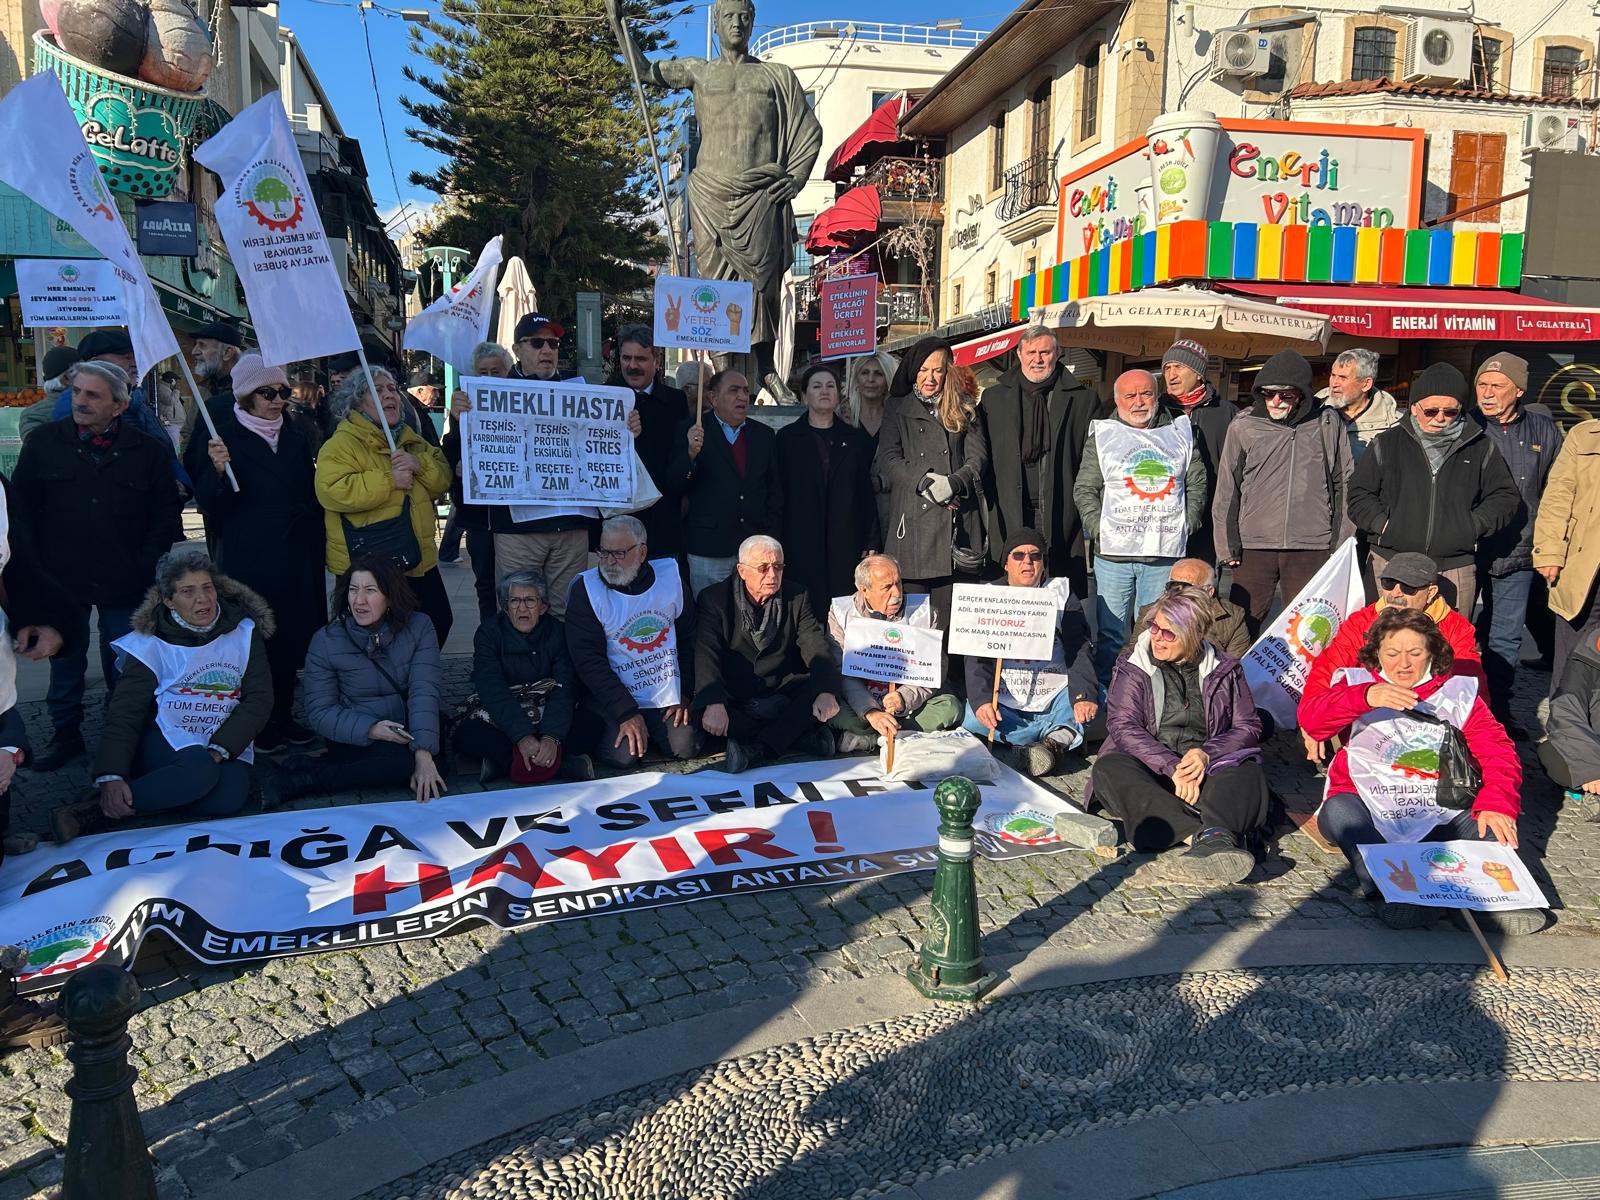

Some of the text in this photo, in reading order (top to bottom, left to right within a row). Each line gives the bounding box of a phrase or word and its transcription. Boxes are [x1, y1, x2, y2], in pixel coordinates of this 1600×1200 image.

[1108, 305, 1207, 318] LA GELATERIA
[1233, 311, 1313, 330] LA GELATERIA
[1331, 315, 1366, 325] ATERIA
[1392, 314, 1496, 331] ENERJİ VİTAMİN
[1521, 320, 1586, 329] LA GELATERIA
[691, 326, 712, 336] SÖZ
[476, 389, 625, 422] EMEKLİ HASTA
[480, 419, 516, 432] TEŞHİS:
[535, 423, 570, 436] TEŞHİS:
[473, 433, 522, 444] KARBONHİDRAT
[587, 427, 621, 440] TEŞHİS:
[534, 436, 570, 447] PROTEİN
[585, 440, 621, 456] STRES
[480, 444, 515, 455] FAZLALIĞI
[478, 461, 519, 474] REÇETE:
[535, 463, 574, 475] REÇETE:
[587, 461, 624, 474] REÇETE:
[484, 474, 514, 489] ZAM
[541, 476, 569, 491] ZAM
[593, 475, 619, 490] ZAM
[1115, 525, 1153, 533] ANTALYA
[958, 595, 983, 603] GERÇEK
[984, 597, 1021, 605] ENFLASYON
[986, 608, 1026, 616] ENFLASYON
[977, 617, 1026, 627] İSTİYORUZ
[971, 628, 989, 636] MAAŞ
[991, 630, 1047, 638] ALDATMACASINA
[987, 642, 1006, 650] SON
[1302, 638, 1314, 651] 2017
[616, 663, 635, 673] TÜM
[1262, 646, 1303, 688] SENDİKASI
[167, 701, 192, 711] TÜM
[182, 714, 224, 726] SENDİK
[353, 811, 845, 915] HAYIR!
[1439, 884, 1471, 895] SÖZ
[112, 903, 185, 961] TÜM
[201, 892, 488, 954] EMEKLİLERİN
[507, 878, 711, 921] SENDİKASI
[731, 857, 882, 889] ANTALYA
[15, 921, 76, 946] KLİLERİN
